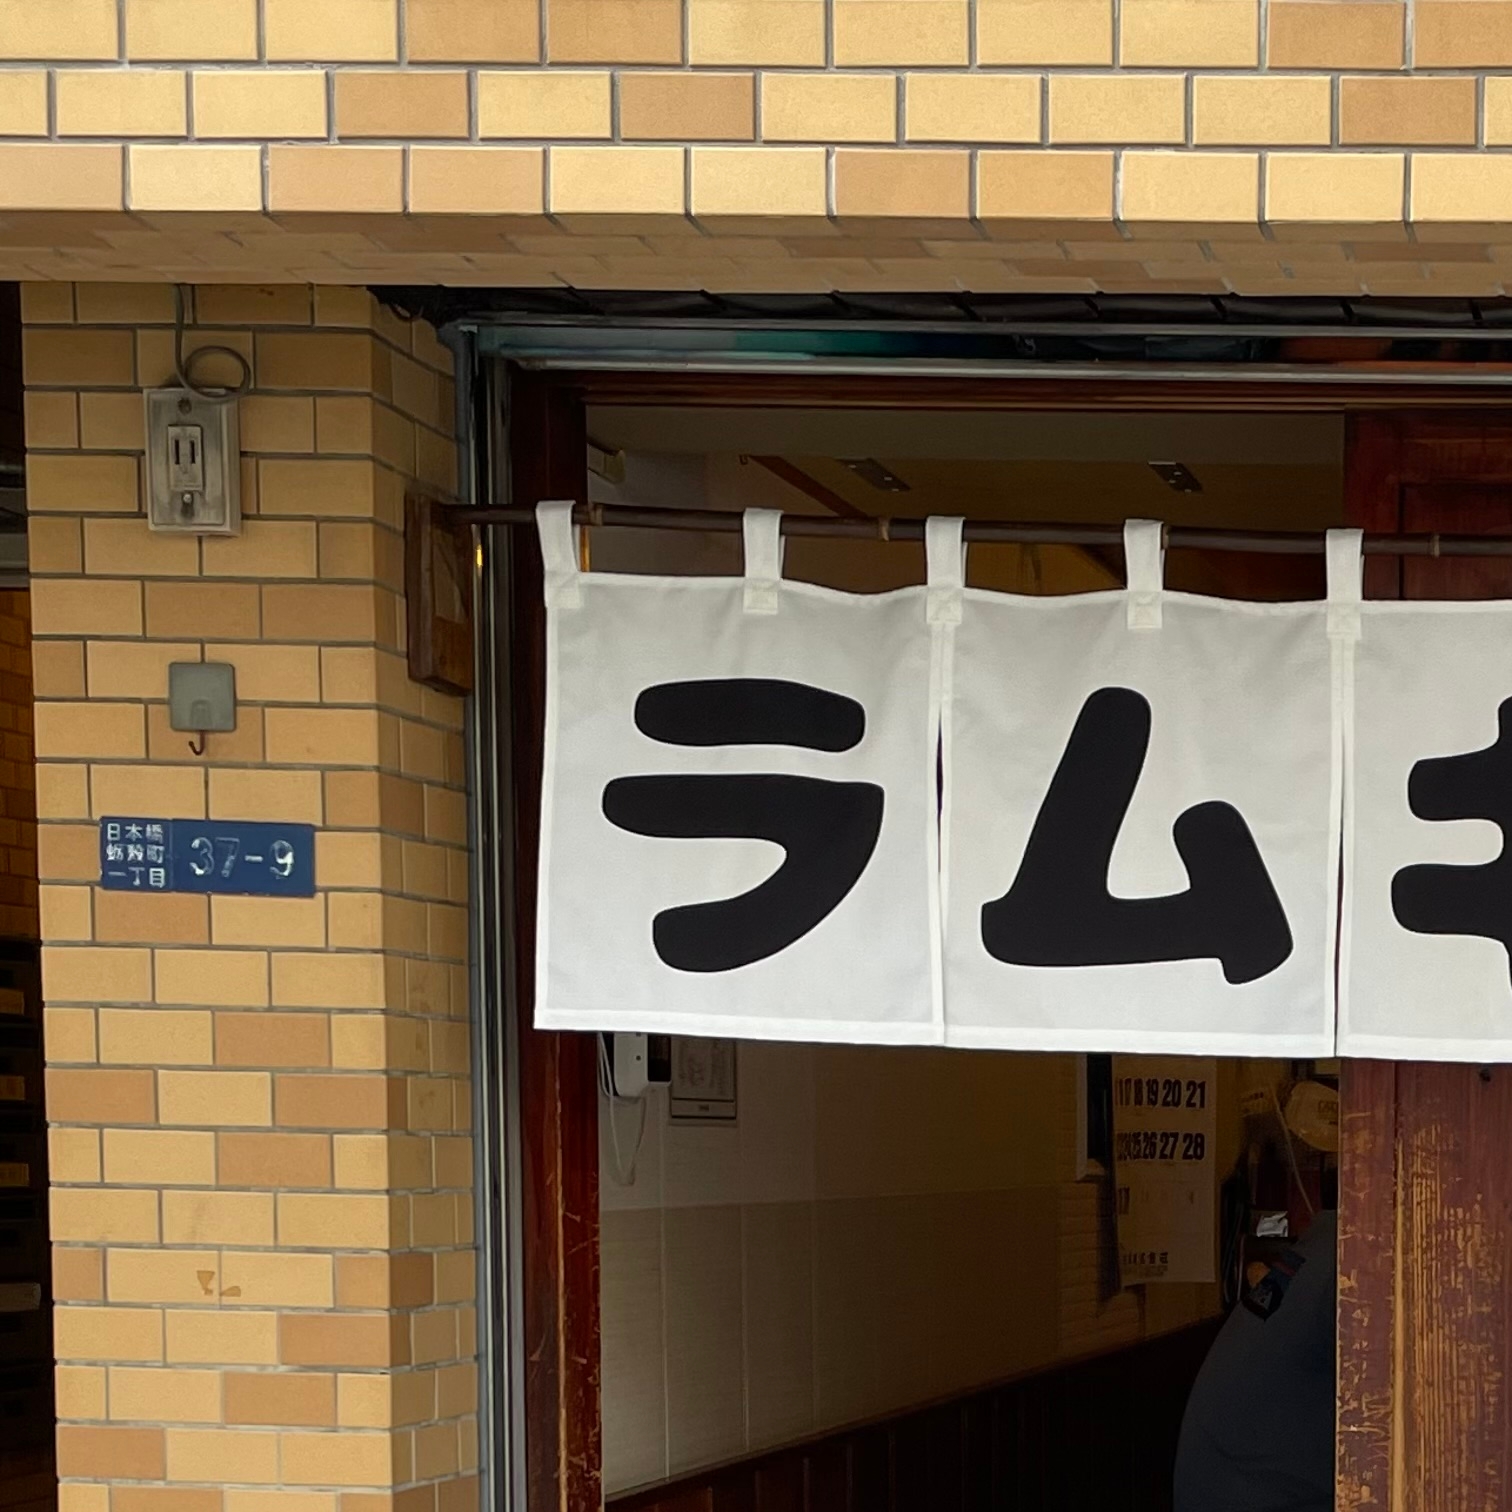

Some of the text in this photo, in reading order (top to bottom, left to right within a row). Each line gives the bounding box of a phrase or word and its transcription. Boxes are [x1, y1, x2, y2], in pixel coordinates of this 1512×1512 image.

[106, 823, 163, 843] 日本橋
[189, 836, 295, 880] 37-9
[107, 866, 166, 888] 一丁目
[1146, 1078, 1159, 1106] 19
[1161, 1078, 1182, 1107] 20
[1185, 1079, 1206, 1109] 21
[1159, 1131, 1179, 1160] 27
[1182, 1132, 1205, 1161] 28
